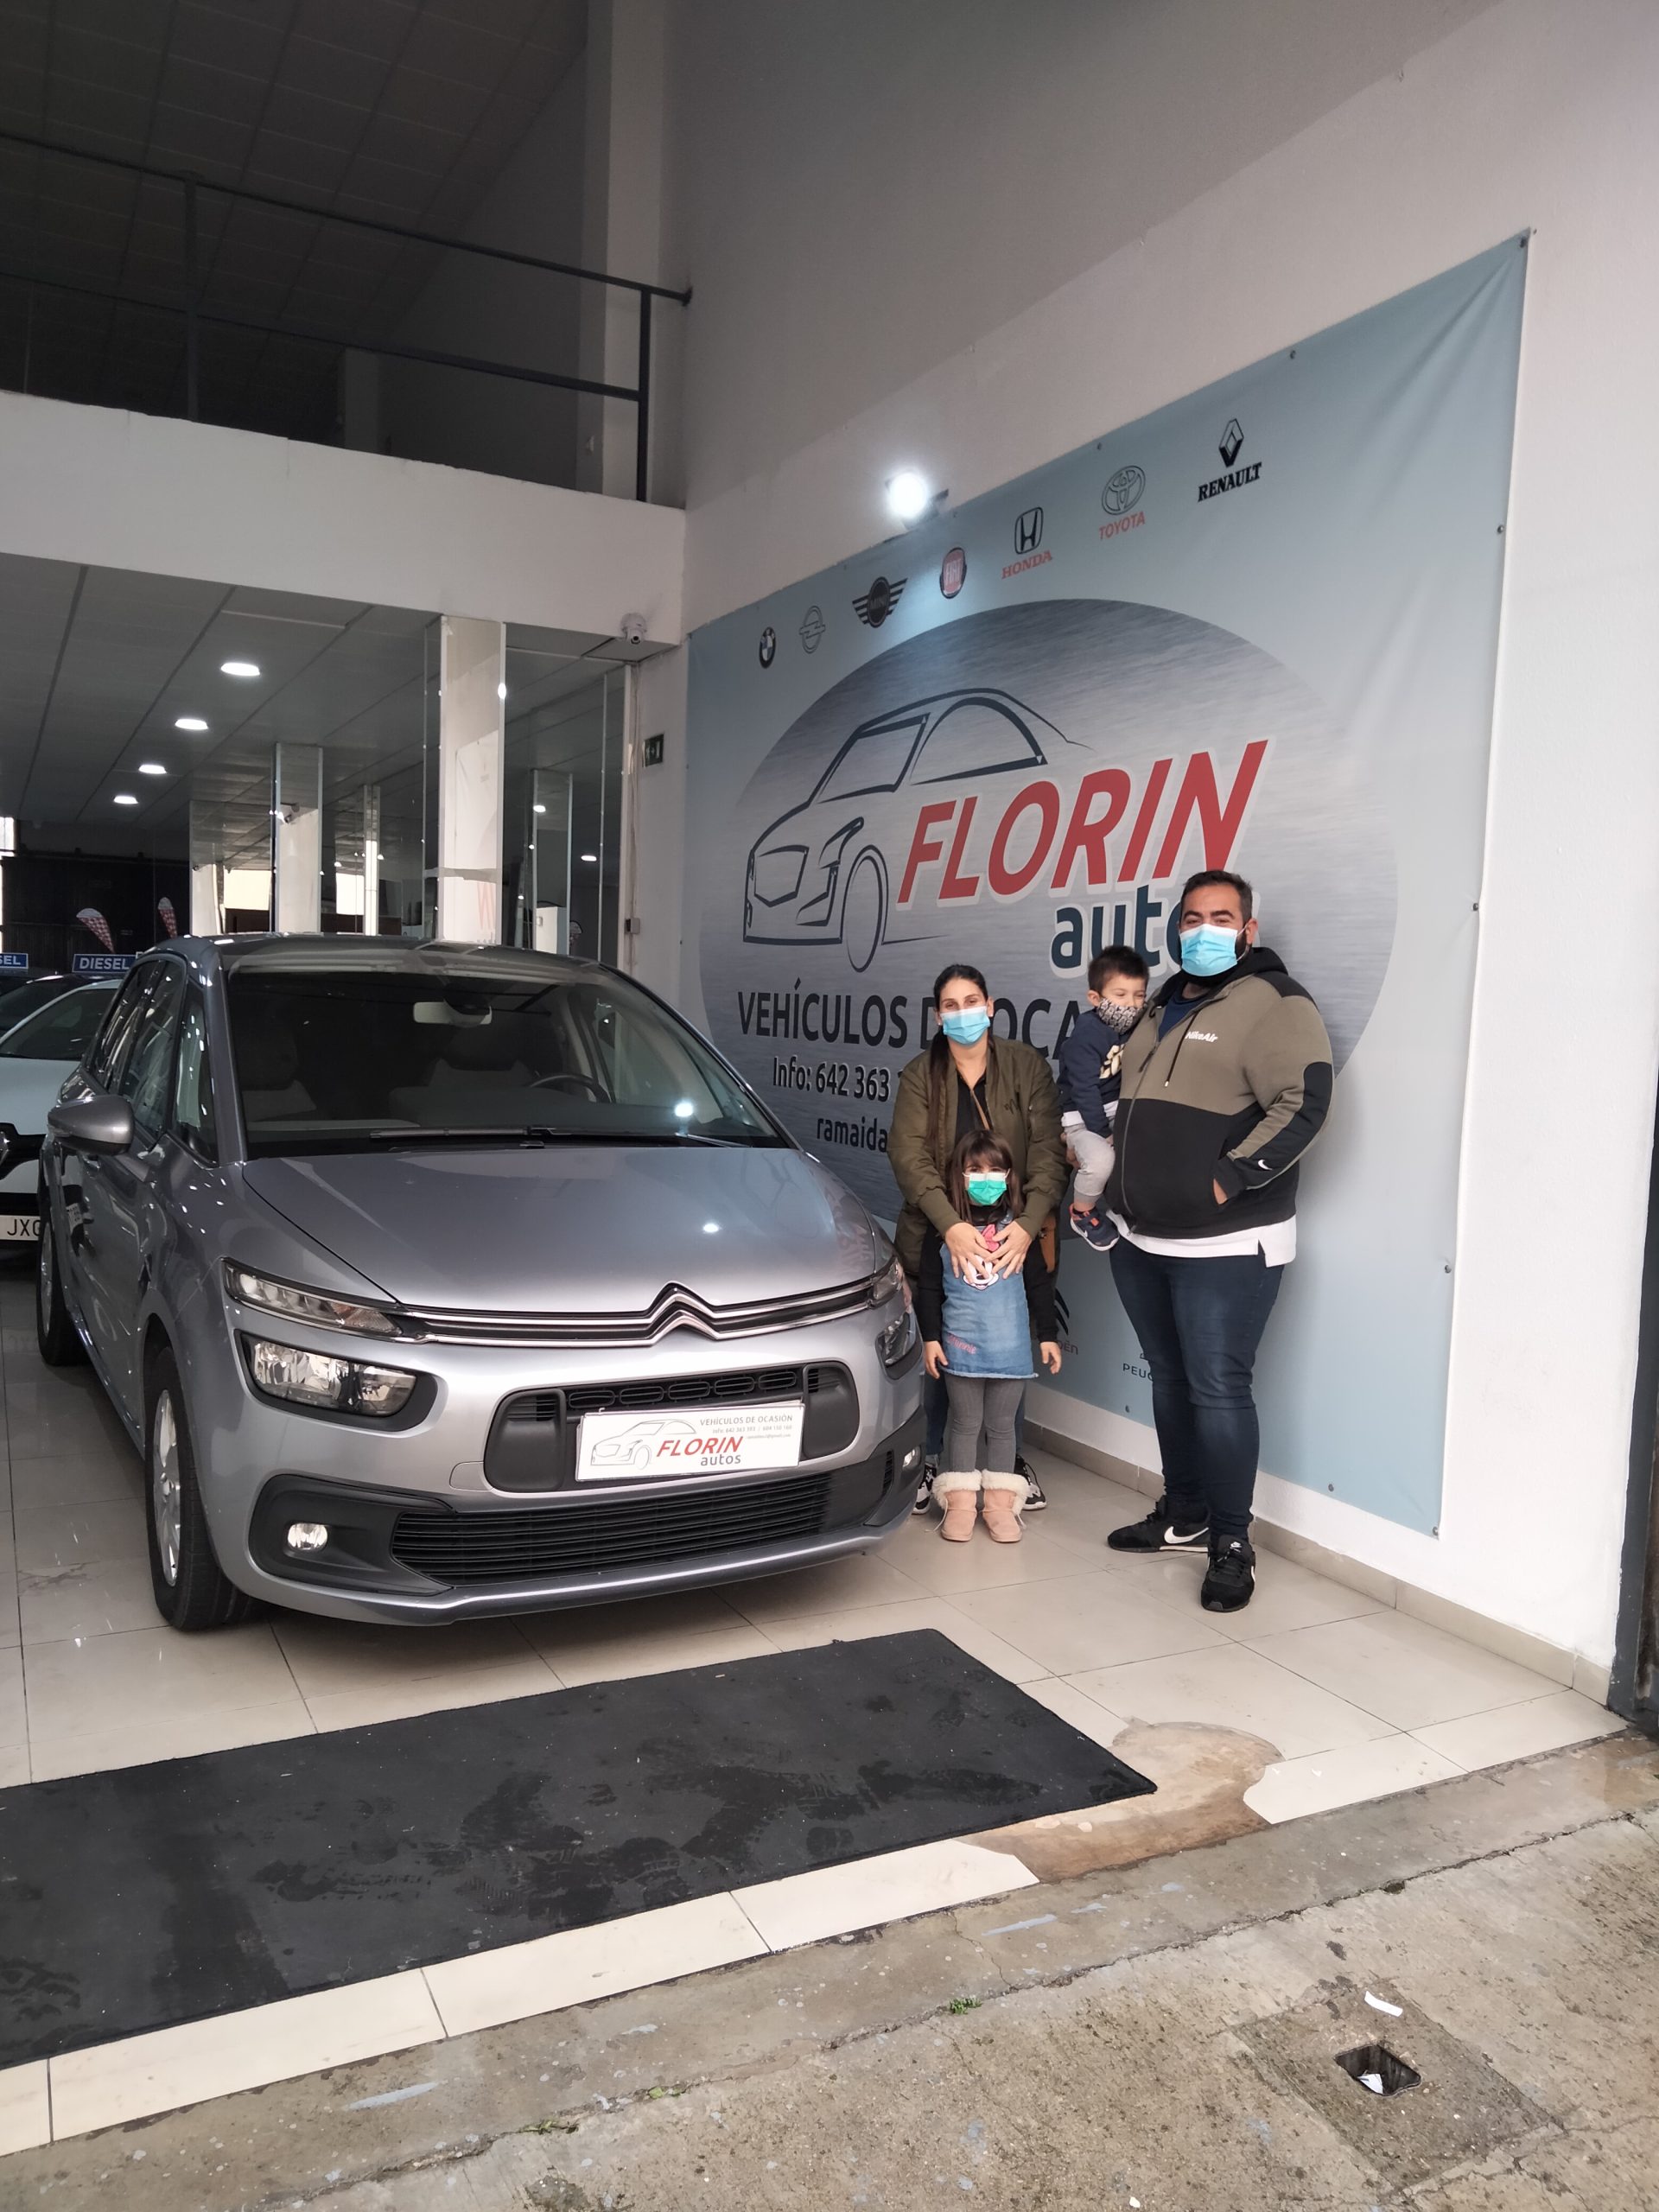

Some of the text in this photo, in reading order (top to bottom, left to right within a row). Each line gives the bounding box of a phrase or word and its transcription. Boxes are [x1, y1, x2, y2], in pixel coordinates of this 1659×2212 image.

[1198, 461, 1262, 503] RENAULT
[1099, 512, 1146, 540] TOYOTA
[1001, 550, 1052, 579] HONDA
[897, 740, 1268, 904] FLORIN
[79, 957, 130, 970] DIESEL
[738, 977, 908, 1048] VEHÍCULOS
[773, 1056, 891, 1103] Info: 642 363
[817, 1116, 888, 1153] ramaida
[700, 1417, 743, 1426] VEHÍCULOS
[758, 1414, 792, 1423] OCASIÓN
[657, 1436, 743, 1457] FLORIN
[701, 1454, 741, 1465] autos
